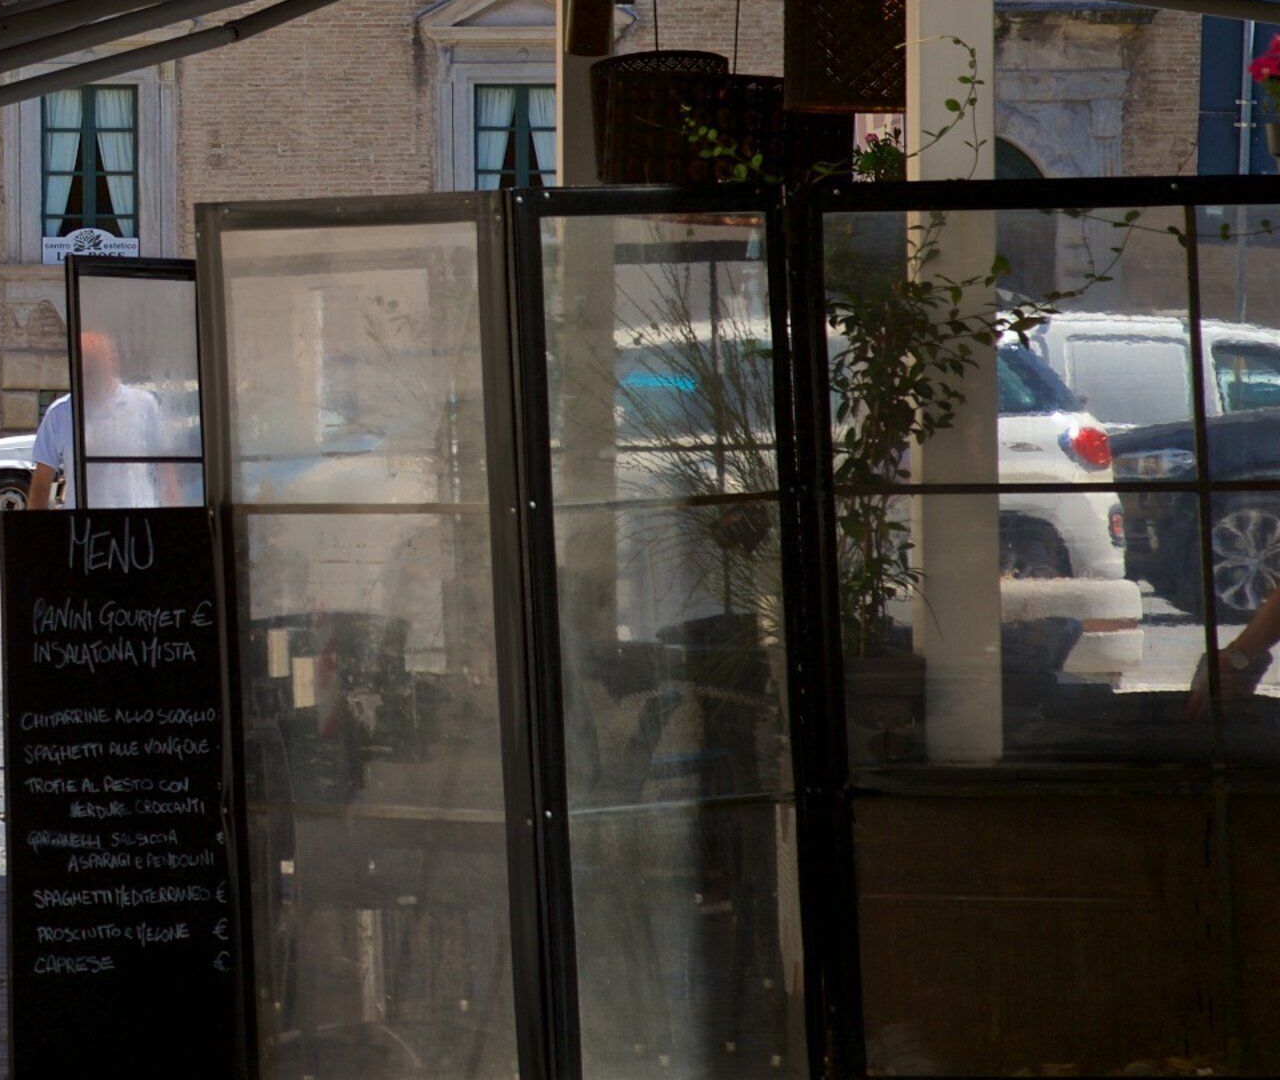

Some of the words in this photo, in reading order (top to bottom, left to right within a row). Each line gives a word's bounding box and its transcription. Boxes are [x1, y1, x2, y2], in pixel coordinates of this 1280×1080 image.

[44, 242, 71, 250] centro
[103, 242, 137, 250] estetico
[68, 515, 155, 576] MENU
[32, 597, 94, 636] PANINI
[98, 600, 186, 634] GOURMET
[190, 600, 214, 628] €
[33, 635, 139, 674] INSALATONA
[142, 637, 197, 669] MISTA
[20, 708, 112, 731] CHITARRINE
[115, 708, 155, 725] ALLO
[157, 707, 217, 727] SCOGLIO
[23, 741, 104, 765] SPAGHETTI
[109, 741, 140, 757] ALLE
[144, 735, 210, 761] VONGOLE
[24, 777, 79, 795] TROFIE
[81, 777, 100, 793] AL
[103, 775, 155, 793] PESTO
[158, 776, 190, 793] CON
[134, 796, 206, 816] CROCCANTI
[67, 852, 131, 873] ASPARAGI
[32, 888, 113, 909] SPAGHETTI
[215, 880, 228, 904] €
[36, 922, 122, 944] PROSCIUTTO
[135, 921, 191, 947] MELONE
[212, 918, 229, 940] €
[33, 954, 117, 974] CAPRESE
